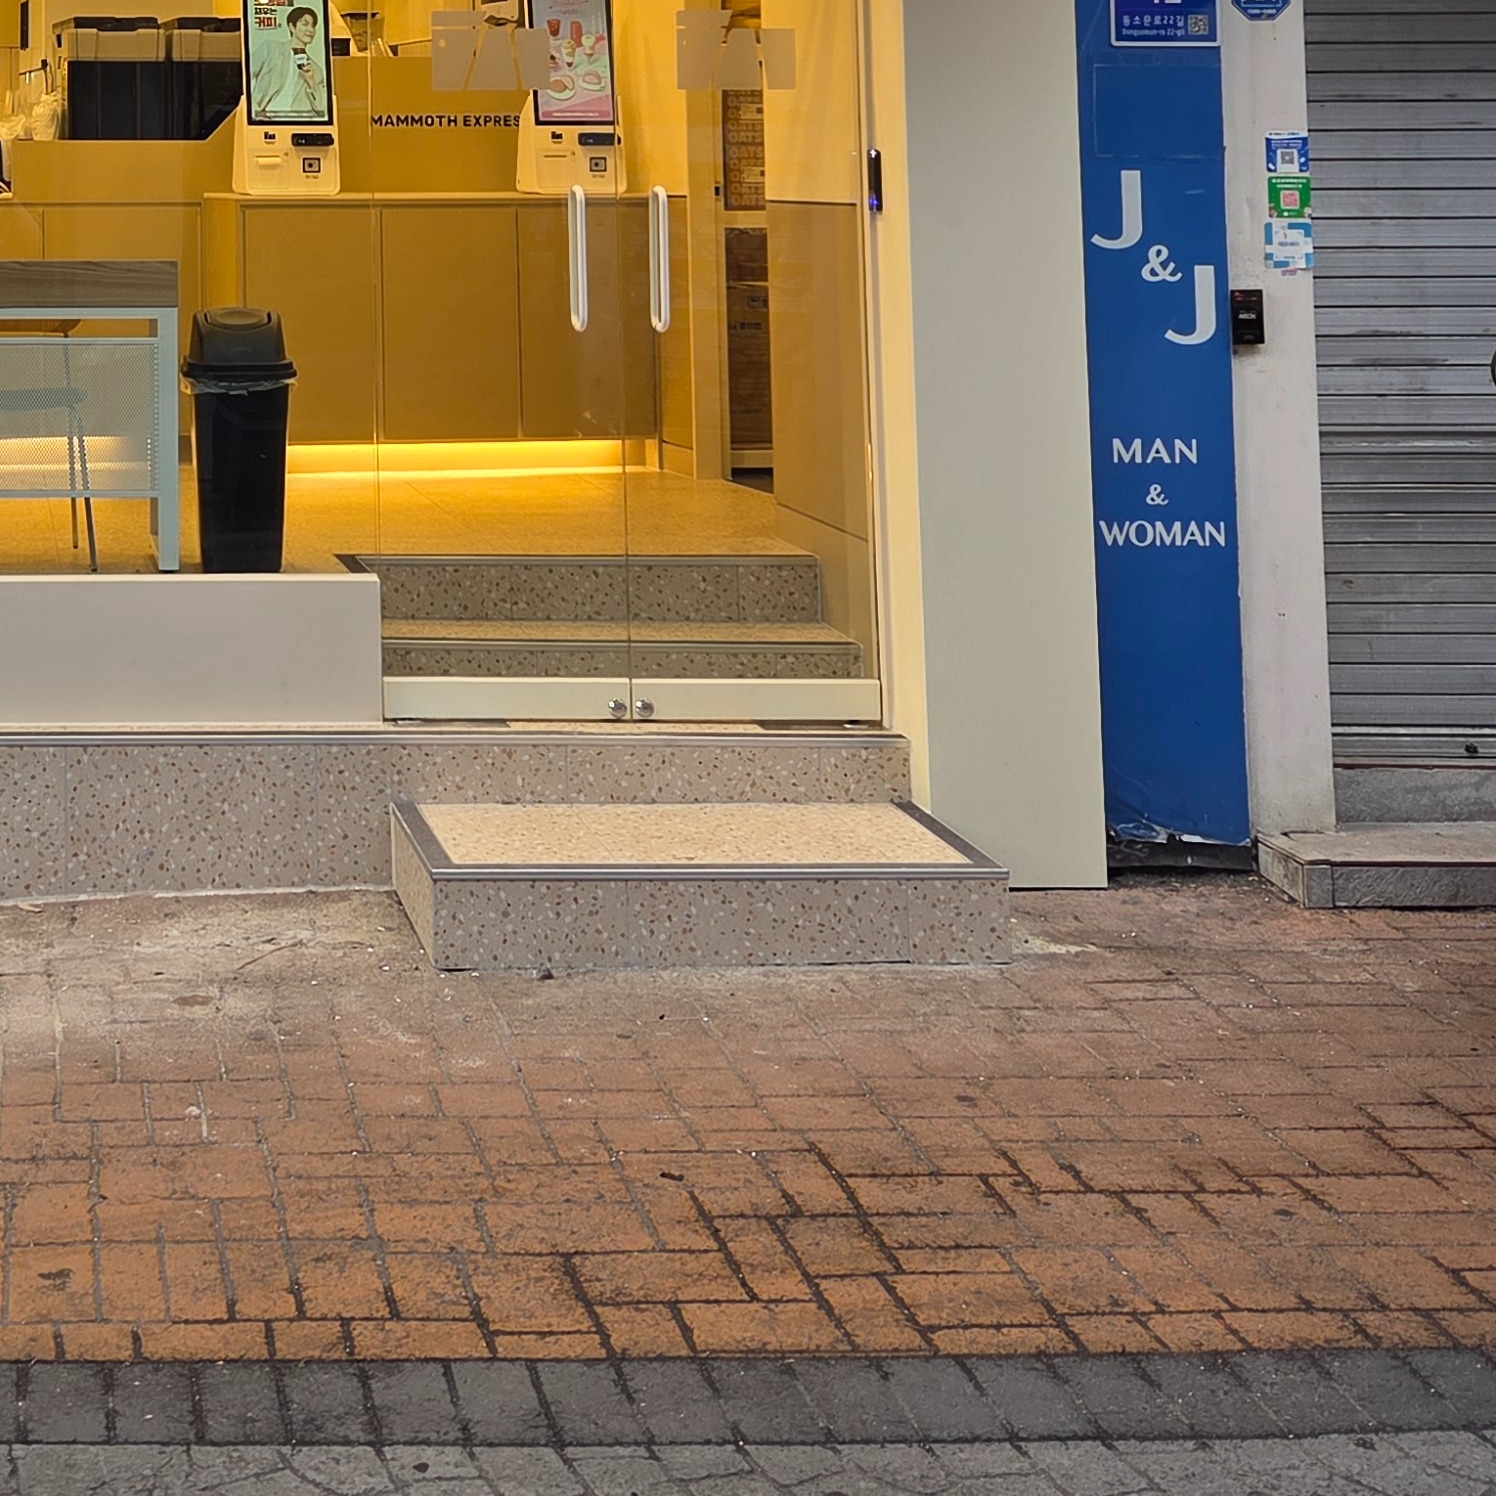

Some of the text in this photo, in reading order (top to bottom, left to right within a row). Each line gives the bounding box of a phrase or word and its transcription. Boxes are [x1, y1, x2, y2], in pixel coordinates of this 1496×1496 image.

[1123, 15, 1184, 27] 동소문로22길
[371, 114, 520, 128] MAMMOTH EXPRES
[1112, 438, 1197, 464] MAN
[1145, 484, 1169, 505] &
[1099, 521, 1226, 547] WOMAN
